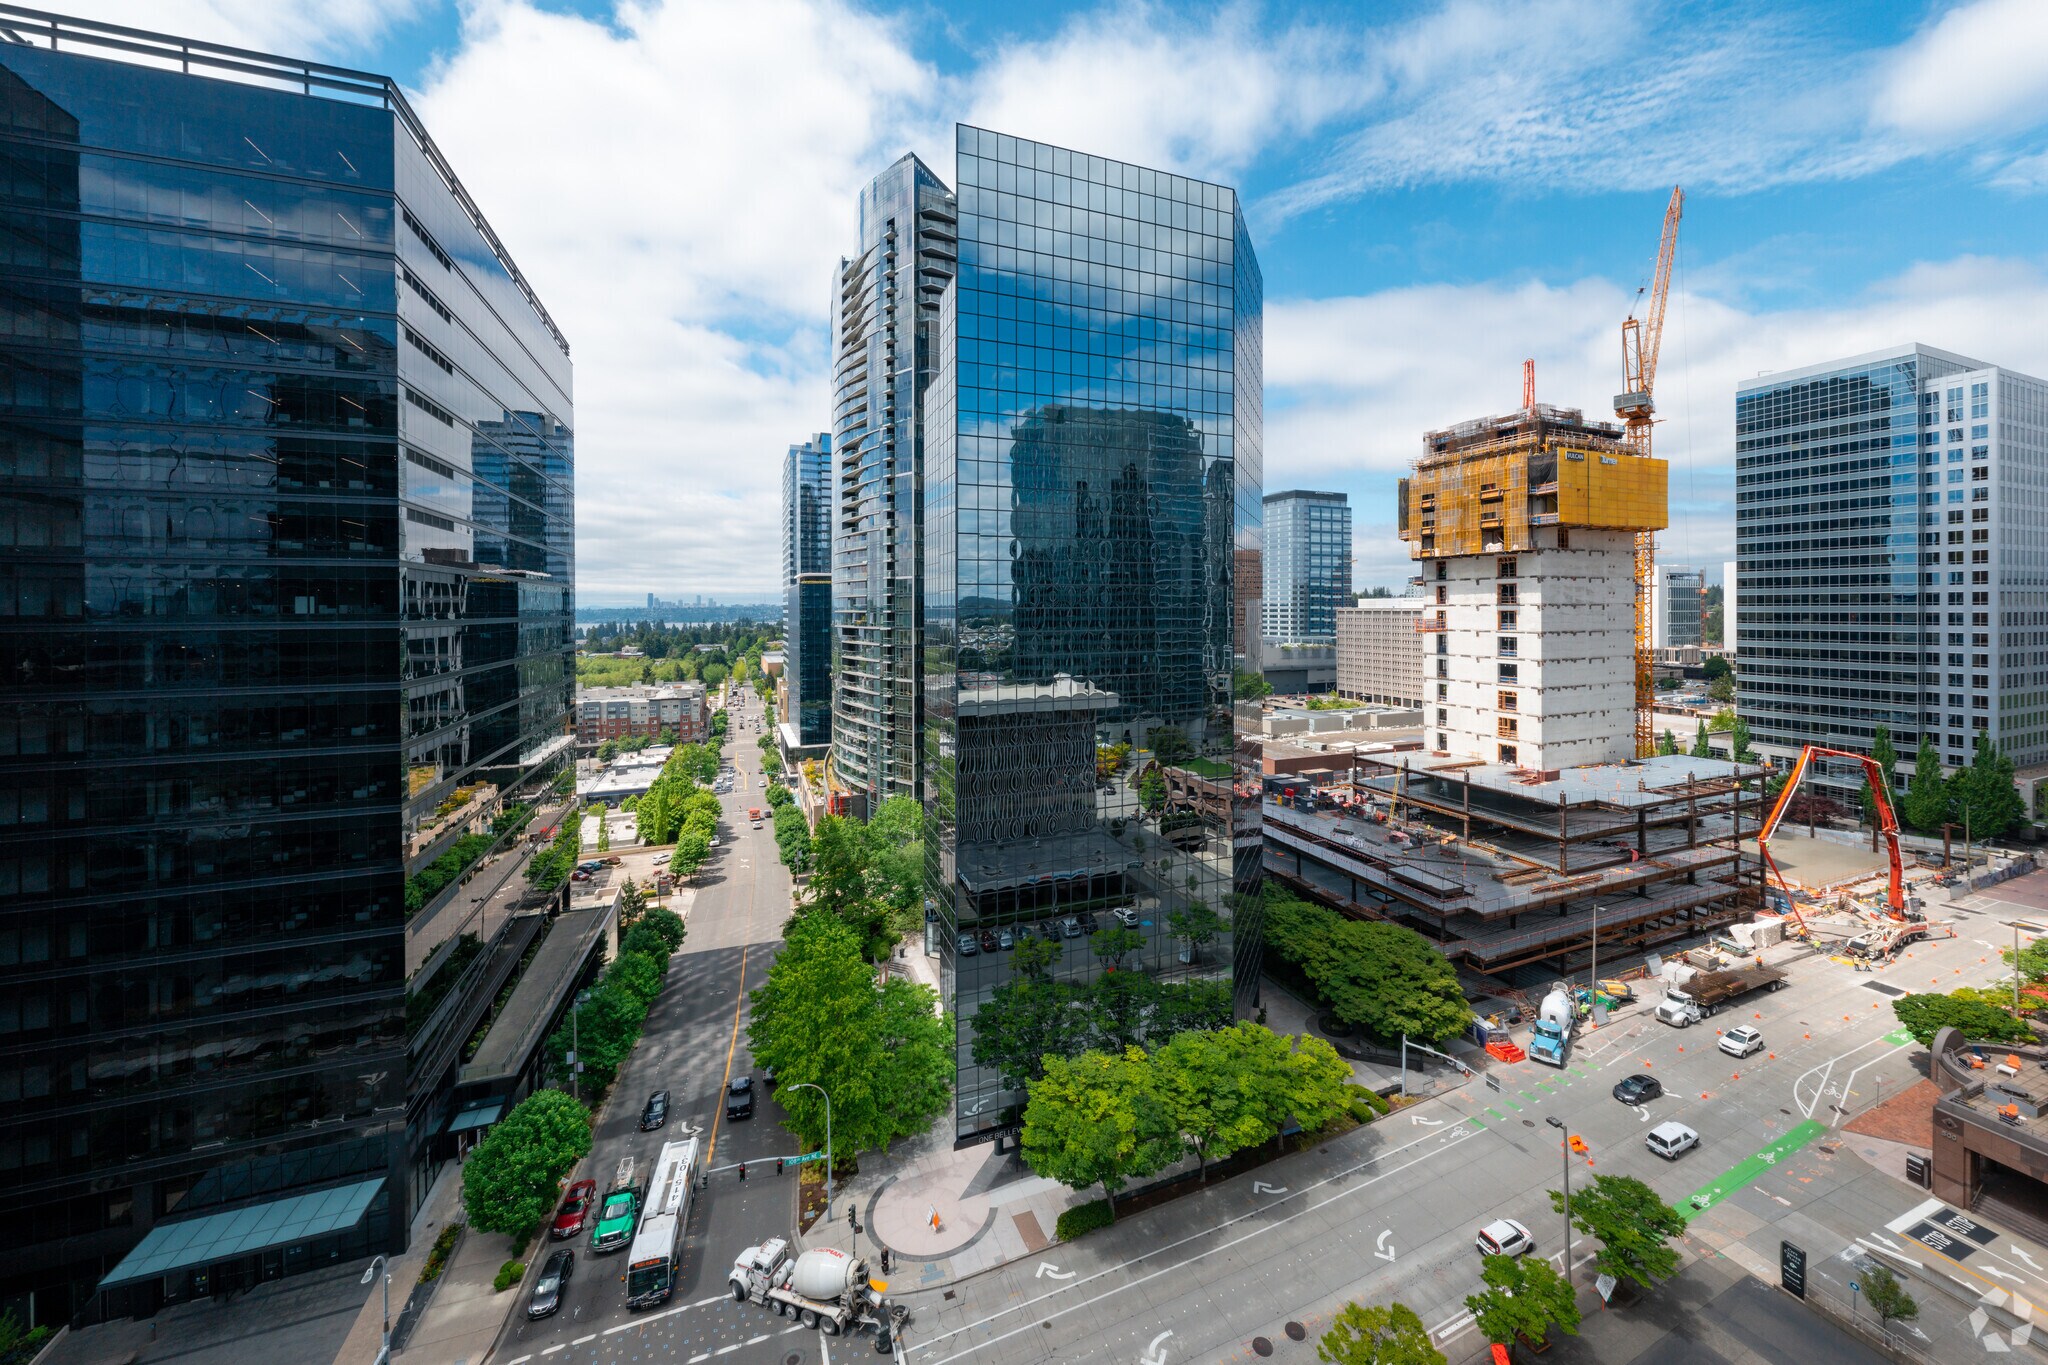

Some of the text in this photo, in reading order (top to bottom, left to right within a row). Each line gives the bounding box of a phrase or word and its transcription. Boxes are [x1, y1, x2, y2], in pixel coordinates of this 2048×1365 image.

[1567, 451, 1584, 460] VULCAN
[979, 1127, 1021, 1144] ONE BELLEV
[1945, 1215, 1977, 1235] STOP
[1920, 1230, 1953, 1251] STOP
